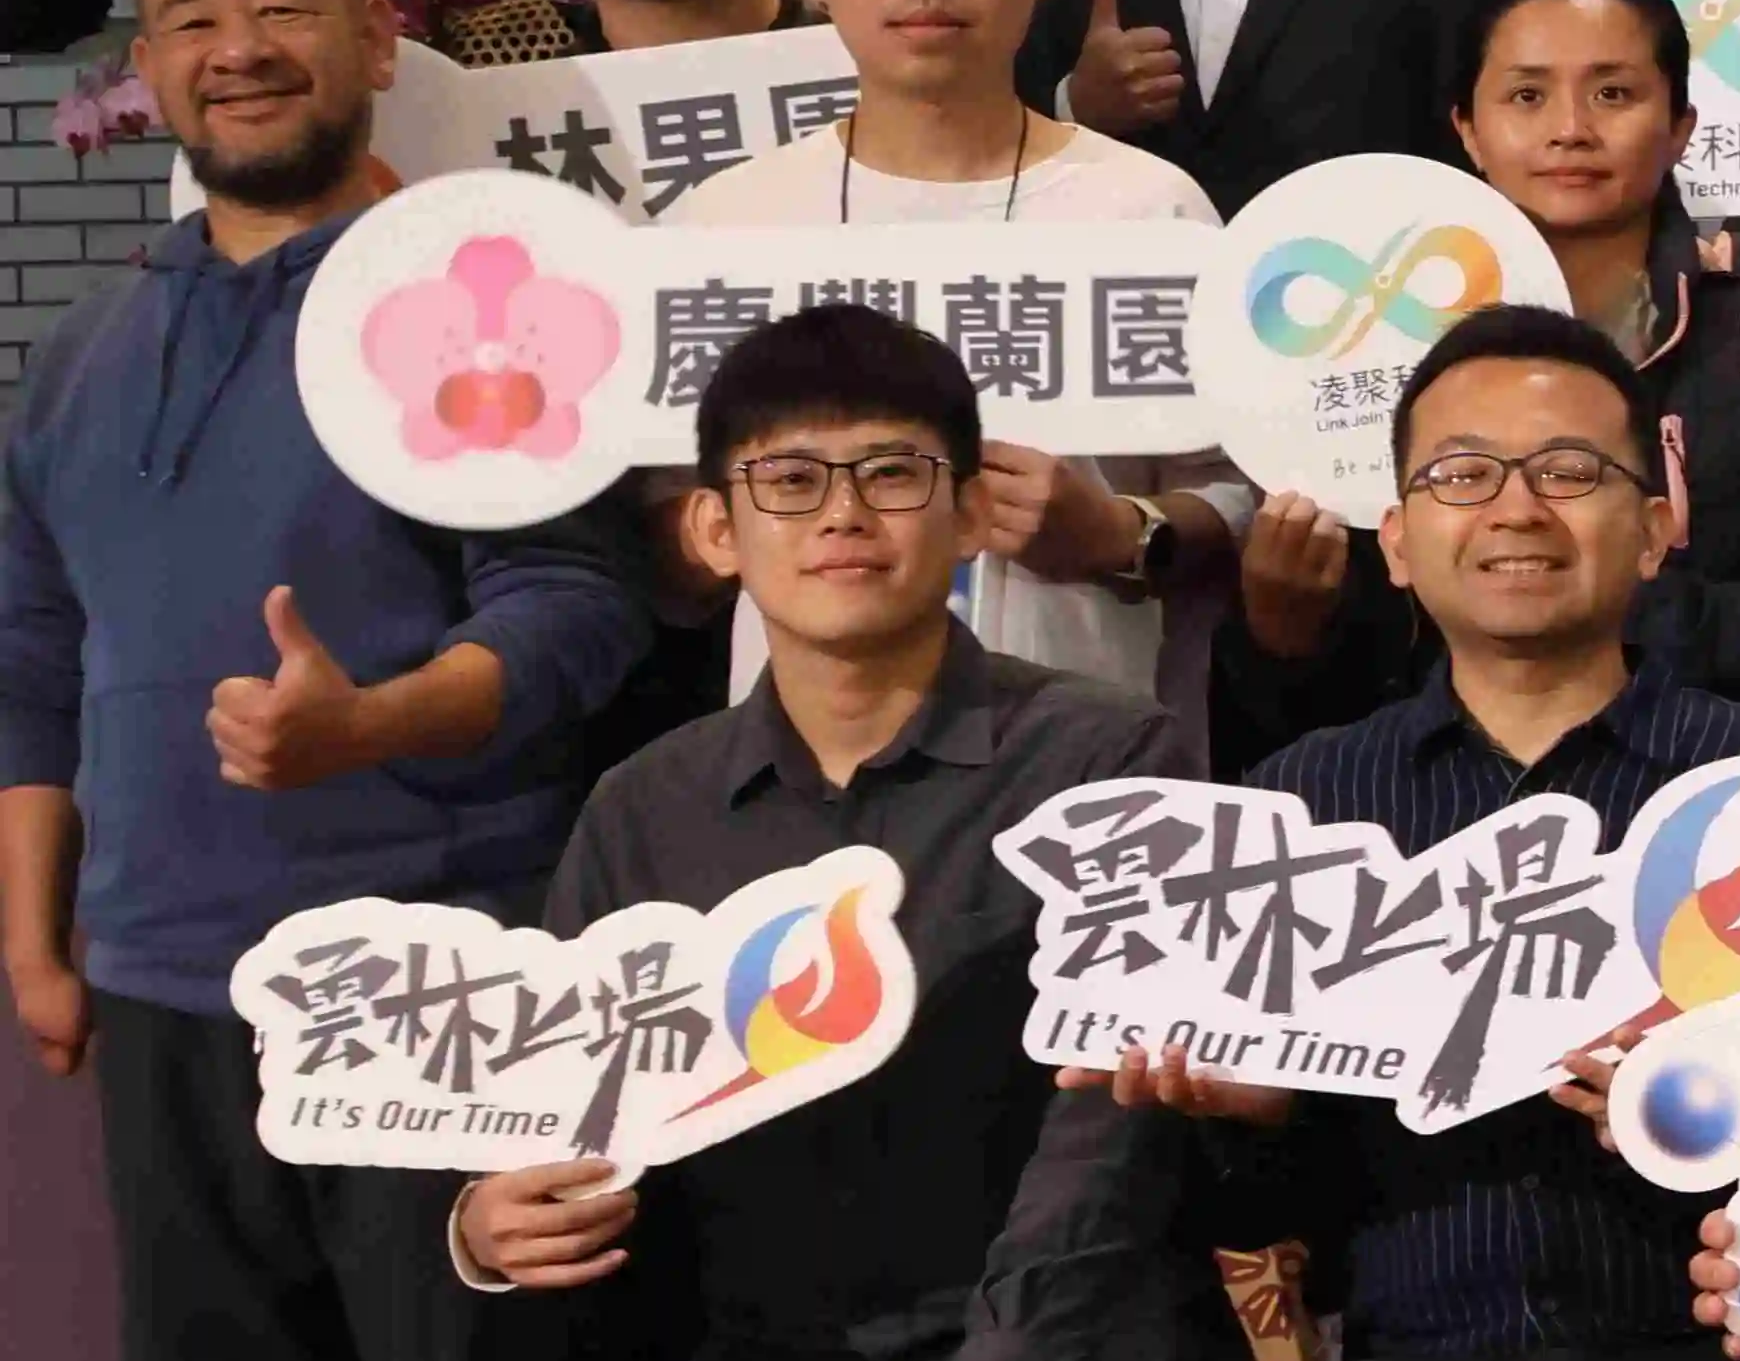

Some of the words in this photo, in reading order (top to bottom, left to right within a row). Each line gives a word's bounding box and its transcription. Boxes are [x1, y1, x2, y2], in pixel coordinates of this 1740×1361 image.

[1020, 788, 1617, 1122] 雲林上場
[264, 936, 714, 1160] 雲林上場
[290, 1095, 364, 1131] It's
[376, 1098, 453, 1135] Our
[459, 1102, 561, 1139] Time
[1268, 1028, 1408, 1081] Time
